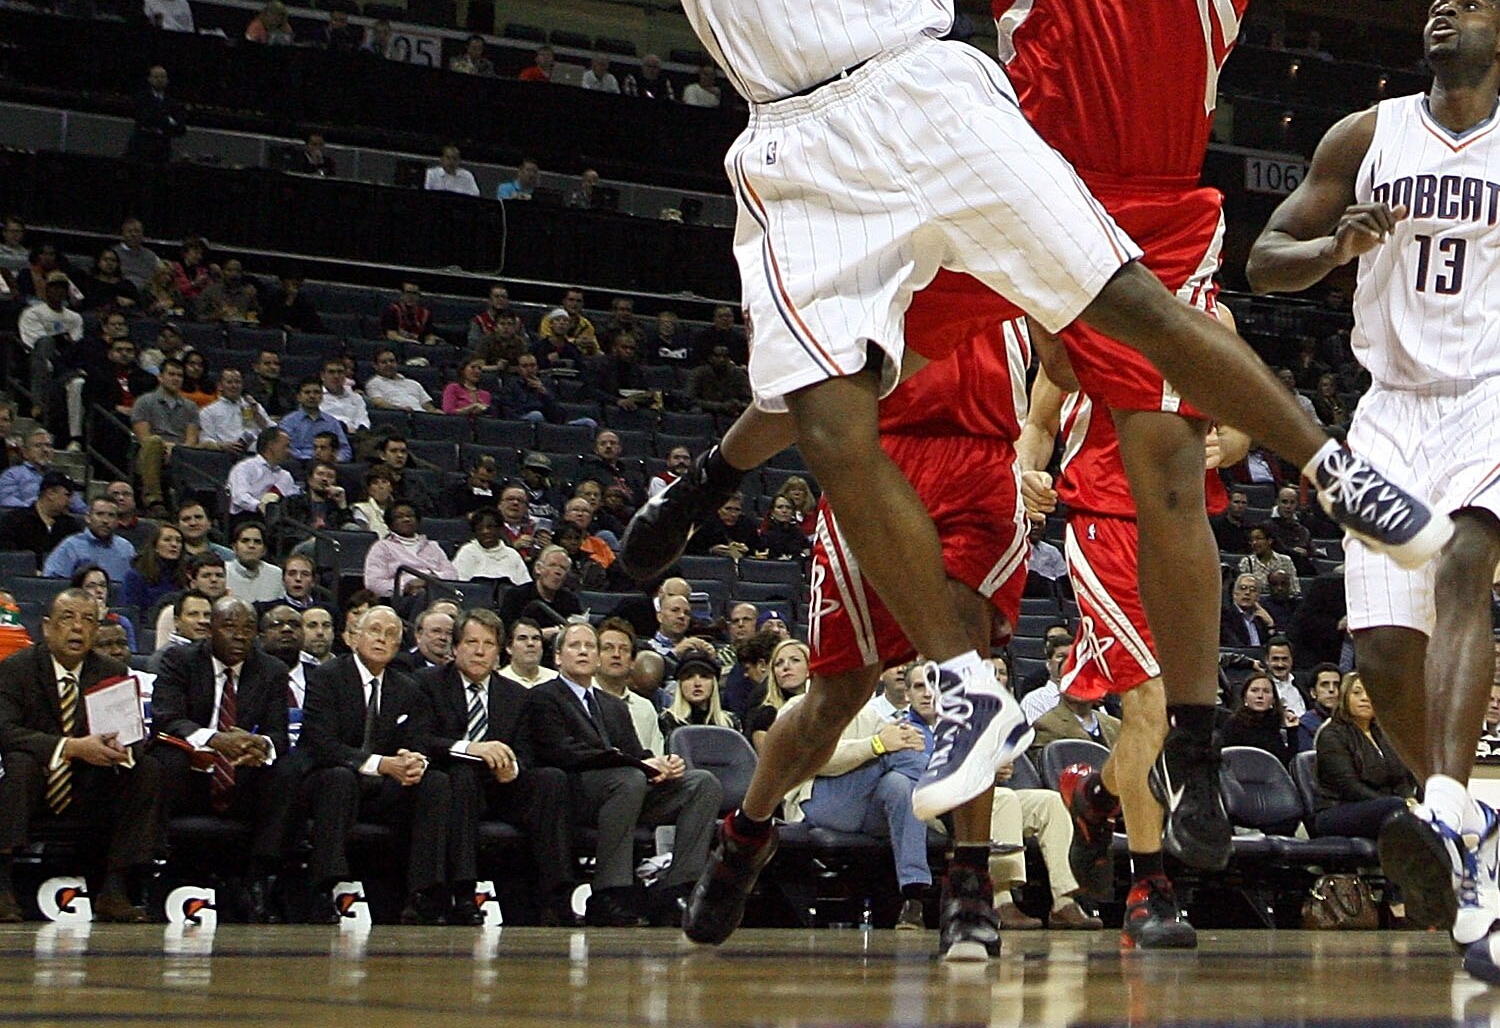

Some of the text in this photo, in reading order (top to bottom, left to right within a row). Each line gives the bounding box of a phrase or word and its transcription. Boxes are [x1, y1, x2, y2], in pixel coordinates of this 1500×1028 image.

[1251, 161, 1299, 191] 106
[1414, 234, 1467, 295] 13
[37, 875, 93, 922] G
[165, 886, 217, 925] G
